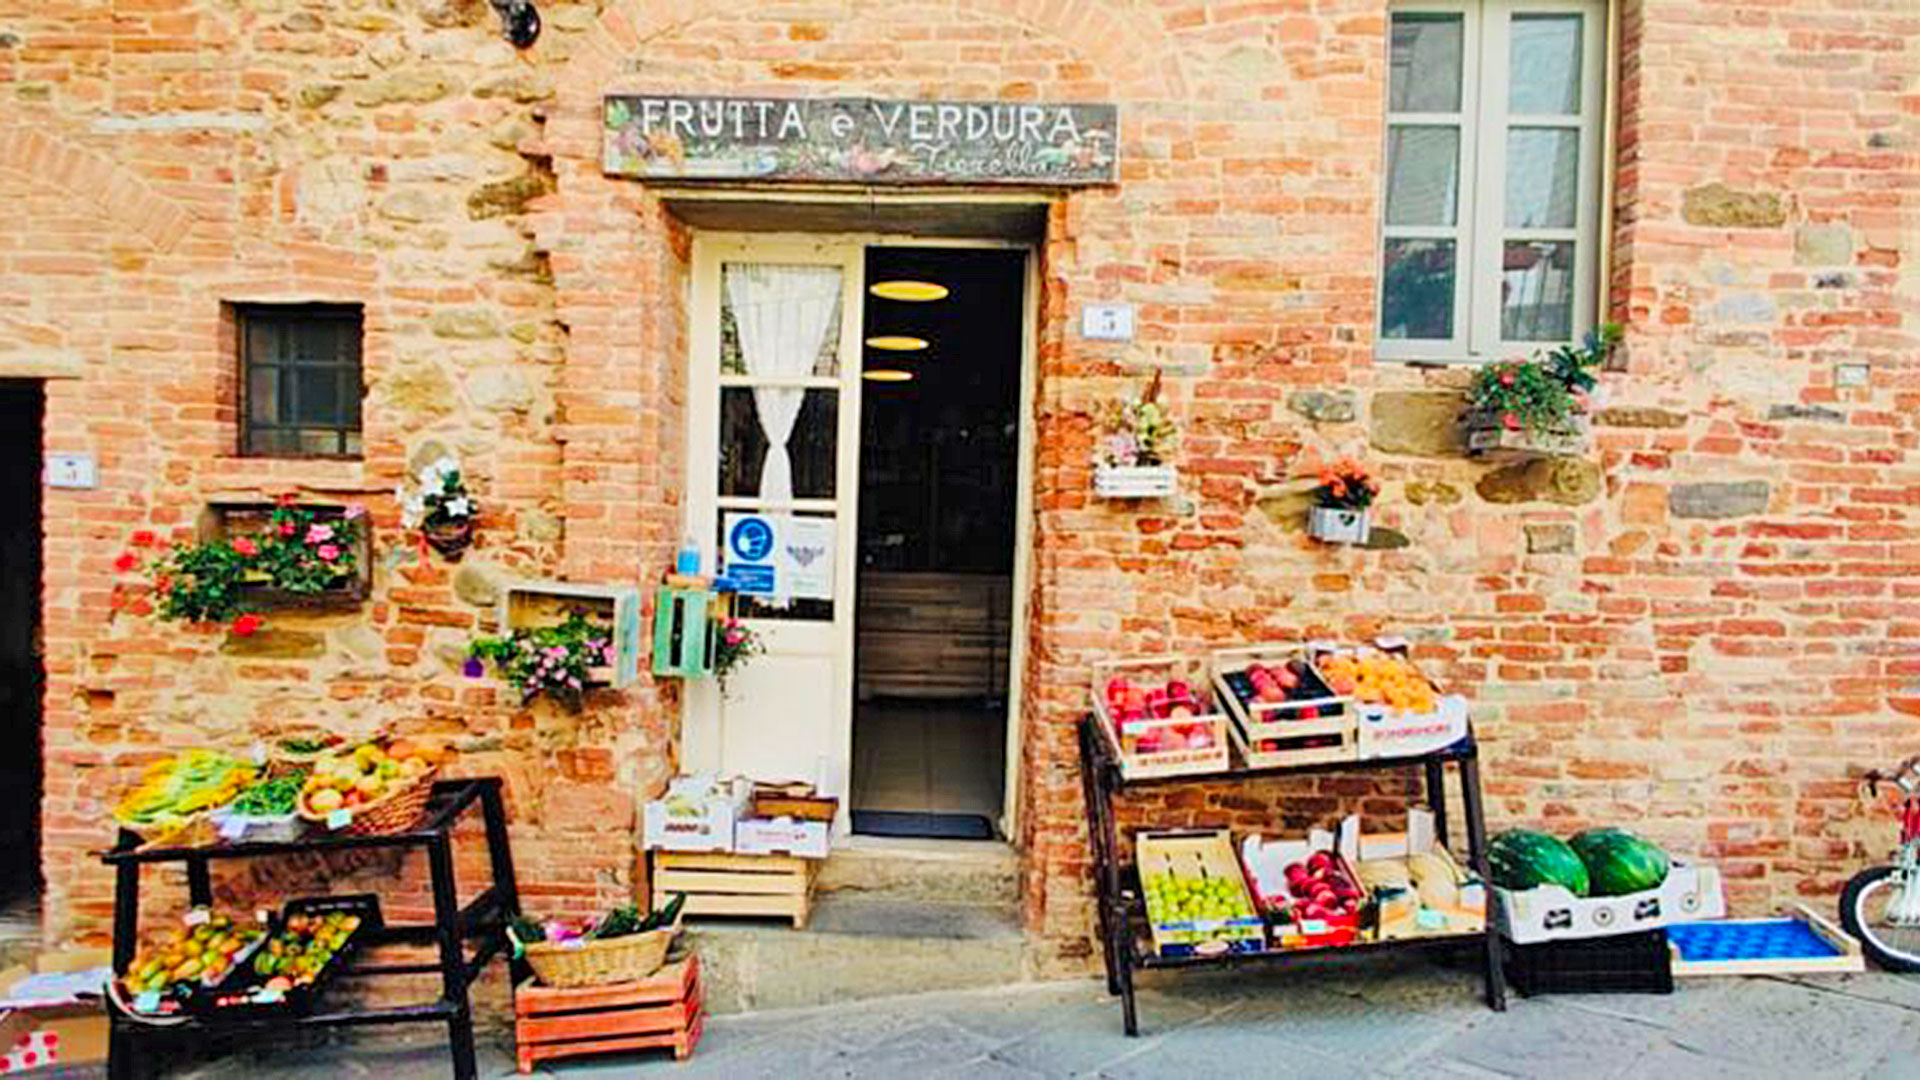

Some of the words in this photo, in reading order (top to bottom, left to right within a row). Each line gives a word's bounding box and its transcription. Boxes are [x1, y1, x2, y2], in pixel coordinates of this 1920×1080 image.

[640, 100, 806, 139] FRUTTA
[830, 113, 855, 138] e
[871, 103, 1081, 142] VERDURA
